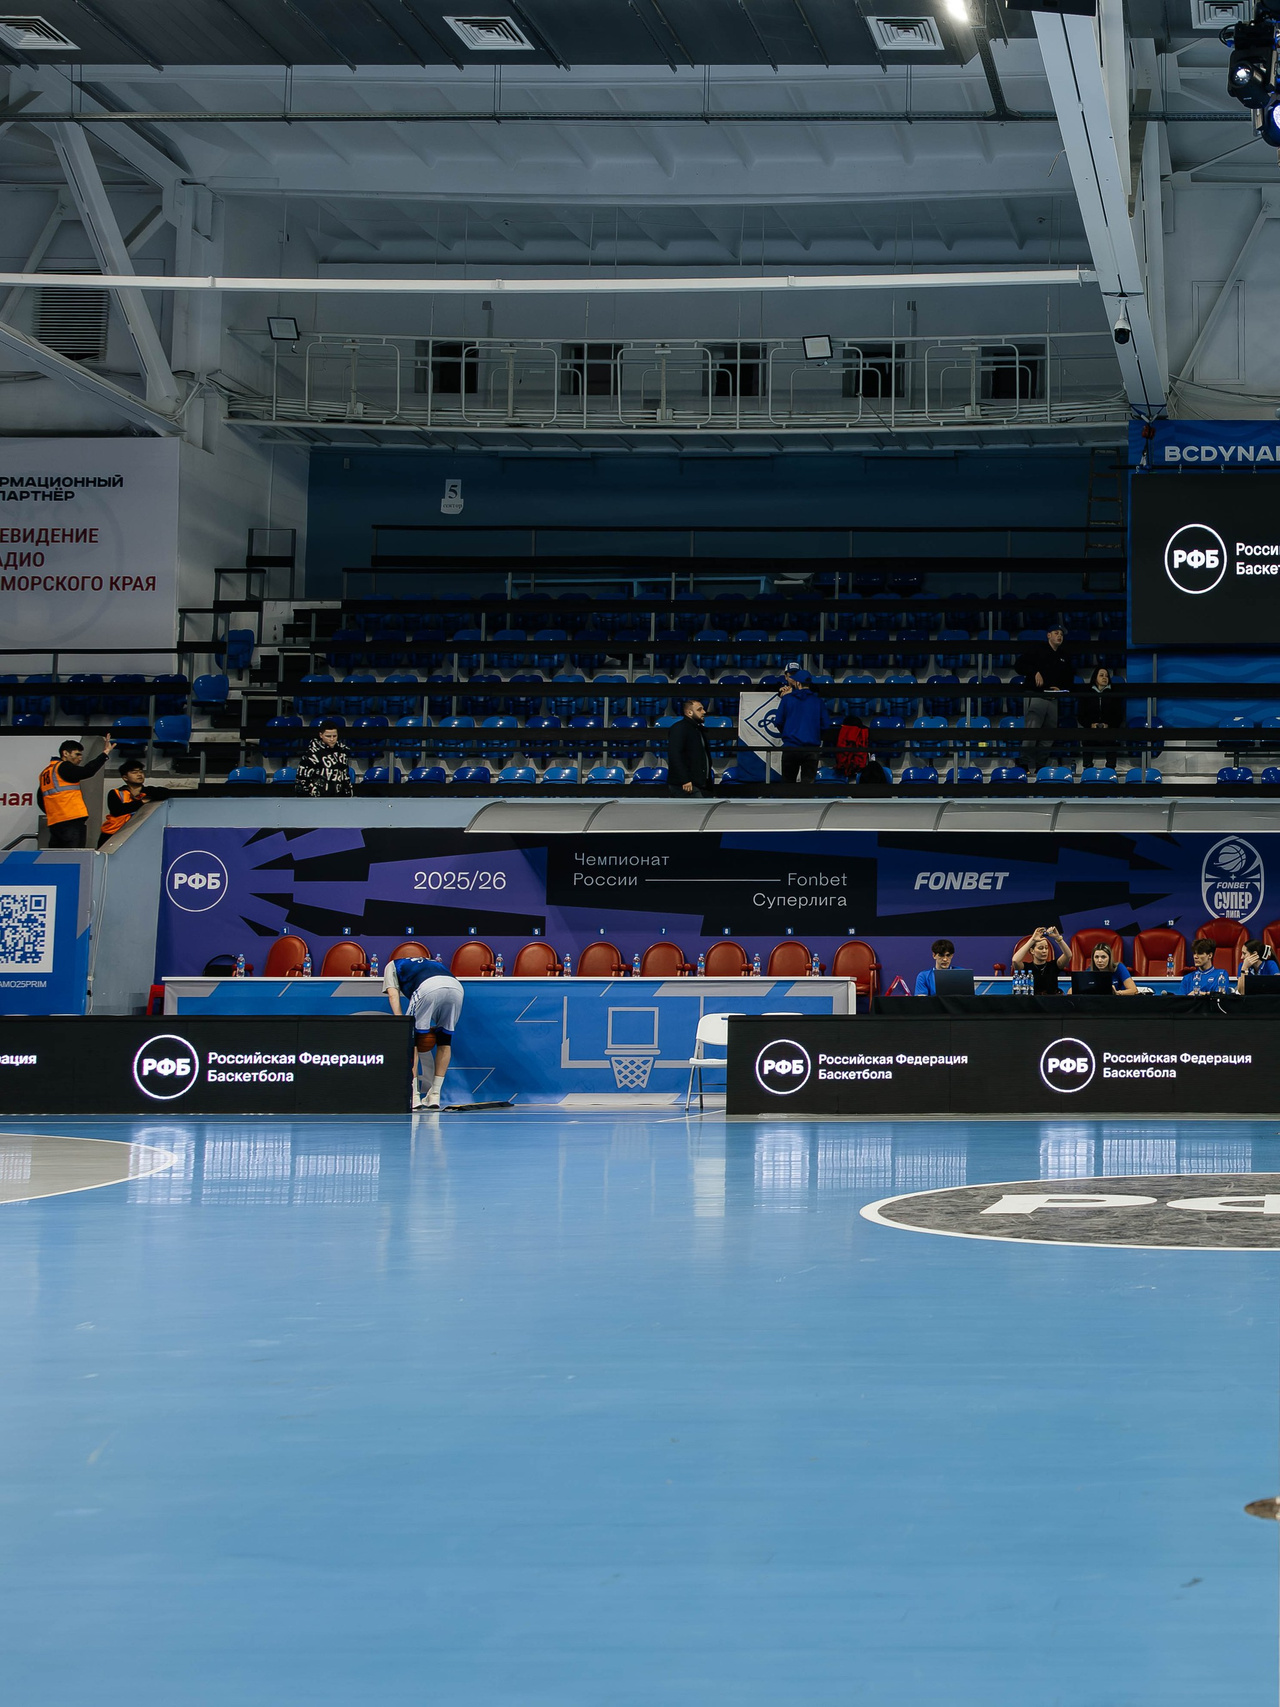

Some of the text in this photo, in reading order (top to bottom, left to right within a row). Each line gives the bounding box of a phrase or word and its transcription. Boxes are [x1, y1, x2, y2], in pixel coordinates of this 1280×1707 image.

[0, 474, 124, 489] РМАЦИОННЫЙ
[448, 484, 458, 499] 5
[0, 527, 99, 547] ЕВИДЕНИЕ
[1173, 549, 1220, 569] РФБ
[0, 575, 156, 592] МОРСКОГО КРАЯ
[574, 852, 670, 866] Чемпионат
[173, 872, 221, 890] РФБ
[413, 870, 507, 892] 2025/26
[573, 872, 848, 887] России Fonbet
[913, 871, 1010, 891] FONBET
[1216, 881, 1251, 889] FONBET
[752, 892, 848, 910] Суперлига
[1214, 891, 1253, 910] СУПЕР
[1225, 910, 1241, 919] ЛИГА
[0, 1054, 37, 1067] ация
[208, 1051, 384, 1067] Российская Федерация
[818, 1053, 968, 1067] Российская Федерация
[1047, 1057, 1089, 1073] РФБ
[1103, 1052, 1252, 1066] Российская Федерация
[142, 1057, 191, 1077] РФБ
[763, 1059, 804, 1075] РФБ
[818, 1068, 893, 1080] Баскетбола
[1103, 1067, 1177, 1078] Баскетбола
[207, 1069, 294, 1083] Баскетбола
